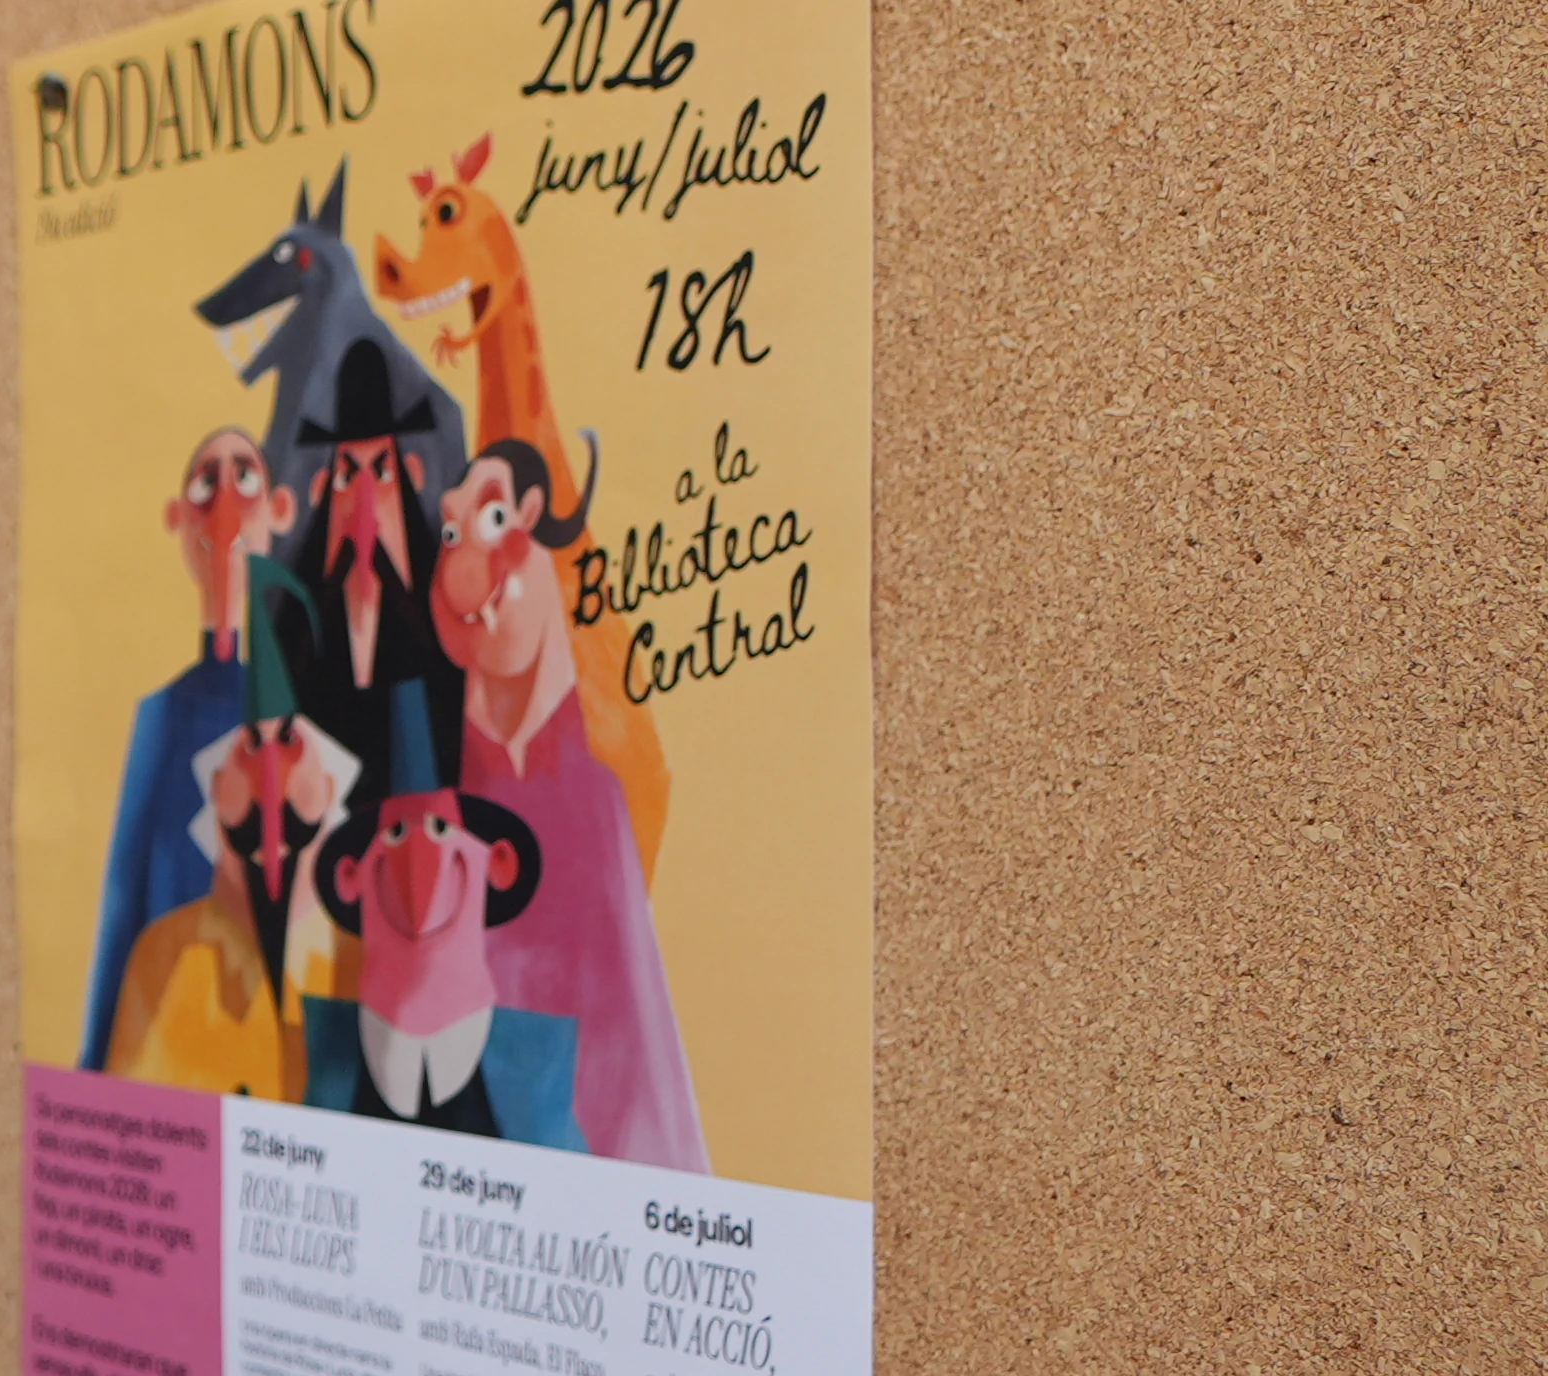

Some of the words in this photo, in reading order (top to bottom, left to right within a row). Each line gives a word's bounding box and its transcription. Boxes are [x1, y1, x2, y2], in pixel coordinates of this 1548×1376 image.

[514, 91, 828, 226] juny/juliol
[635, 248, 772, 372] 18h
[675, 468, 705, 505] a
[714, 420, 760, 485] la
[572, 494, 813, 630] Biblioteca
[624, 560, 816, 705] Central
[240, 1126, 262, 1156] 22
[262, 1134, 286, 1159] de
[286, 1136, 327, 1174] juny
[419, 1159, 445, 1191] 29
[449, 1165, 475, 1197] de
[478, 1168, 526, 1215] juny
[290, 1226, 355, 1278] LLOPS
[417, 1205, 448, 1252] LA
[453, 1212, 525, 1270] VOLTA
[530, 1231, 561, 1277] AL
[564, 1231, 632, 1289] MÓN
[644, 1200, 661, 1232] 6
[663, 1205, 694, 1238] de
[695, 1209, 754, 1249] juliol
[417, 1252, 479, 1303] D'UN
[480, 1267, 609, 1344] PALLASSO,
[643, 1250, 757, 1316] CONTES
[419, 1318, 448, 1343] amb
[642, 1302, 685, 1351] EN
